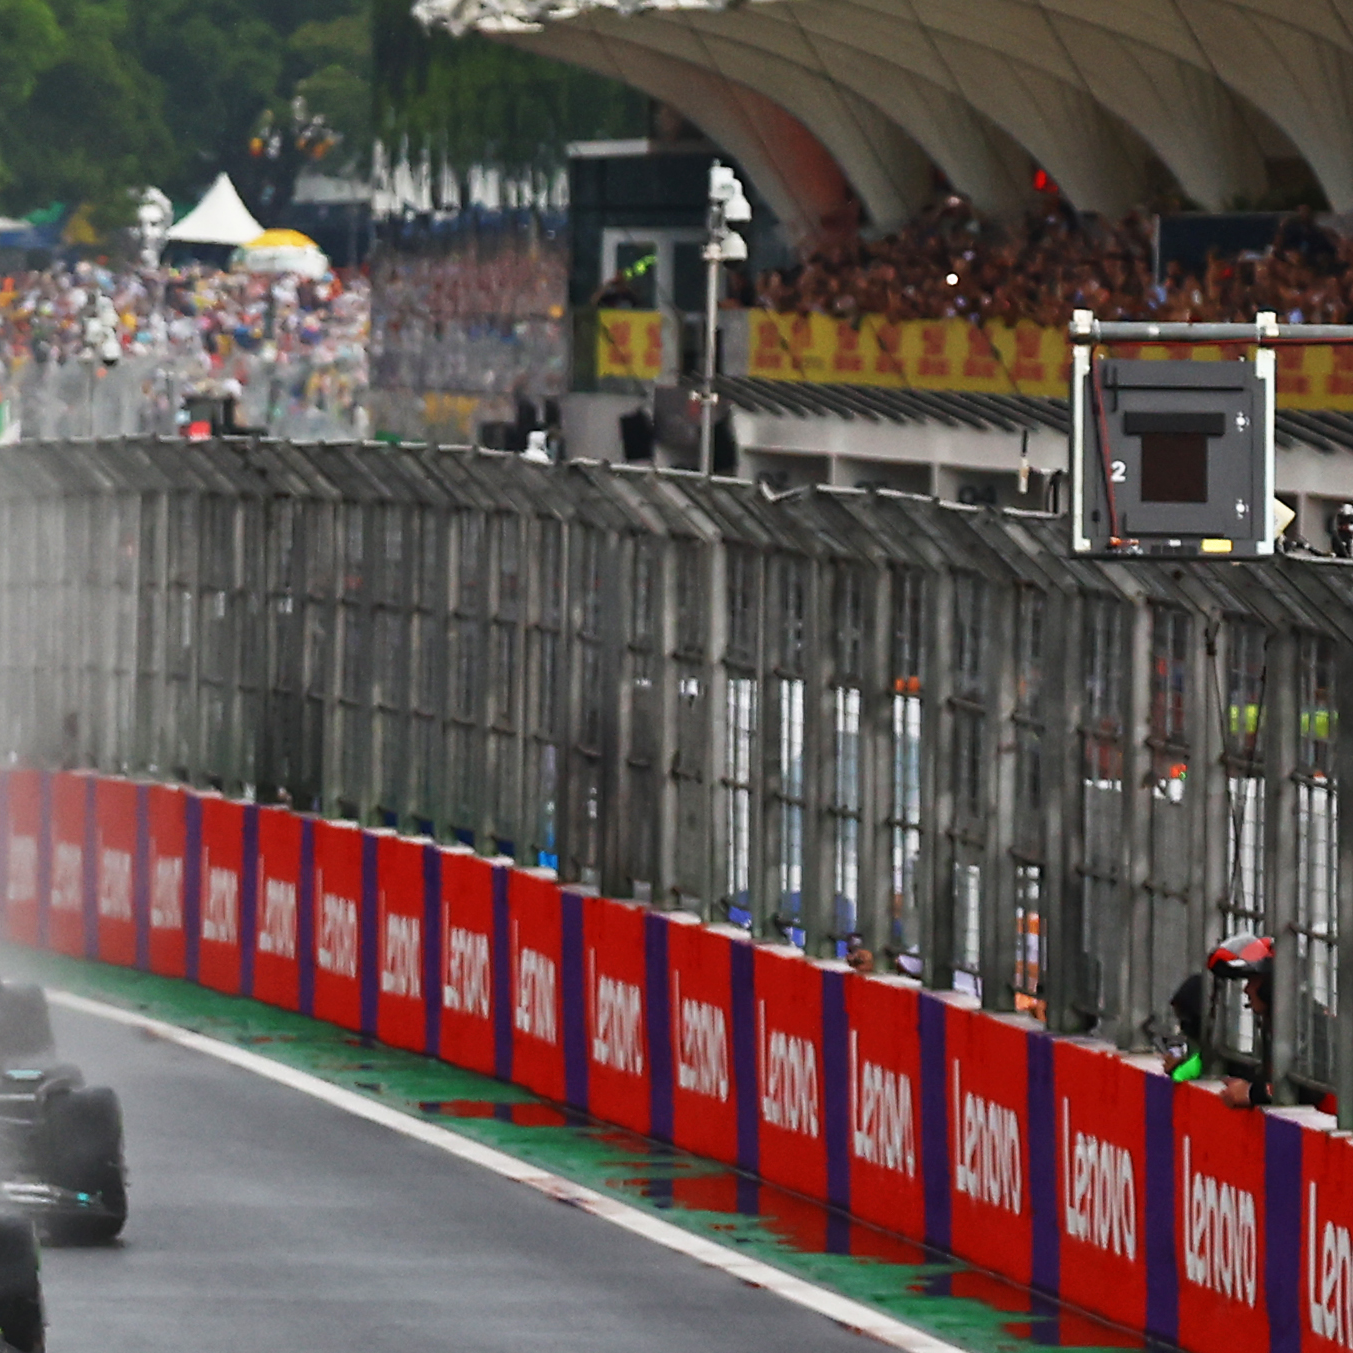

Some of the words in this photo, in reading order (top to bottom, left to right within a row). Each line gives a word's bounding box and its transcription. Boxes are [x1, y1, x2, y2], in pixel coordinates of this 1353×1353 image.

[1110, 460, 1127, 483] 2
[953, 1058, 1024, 1218] Lenovo
[1062, 1096, 1137, 1264] Lenovo
[1182, 1134, 1258, 1309] Lenovo
[1309, 1180, 1353, 1352] Len
